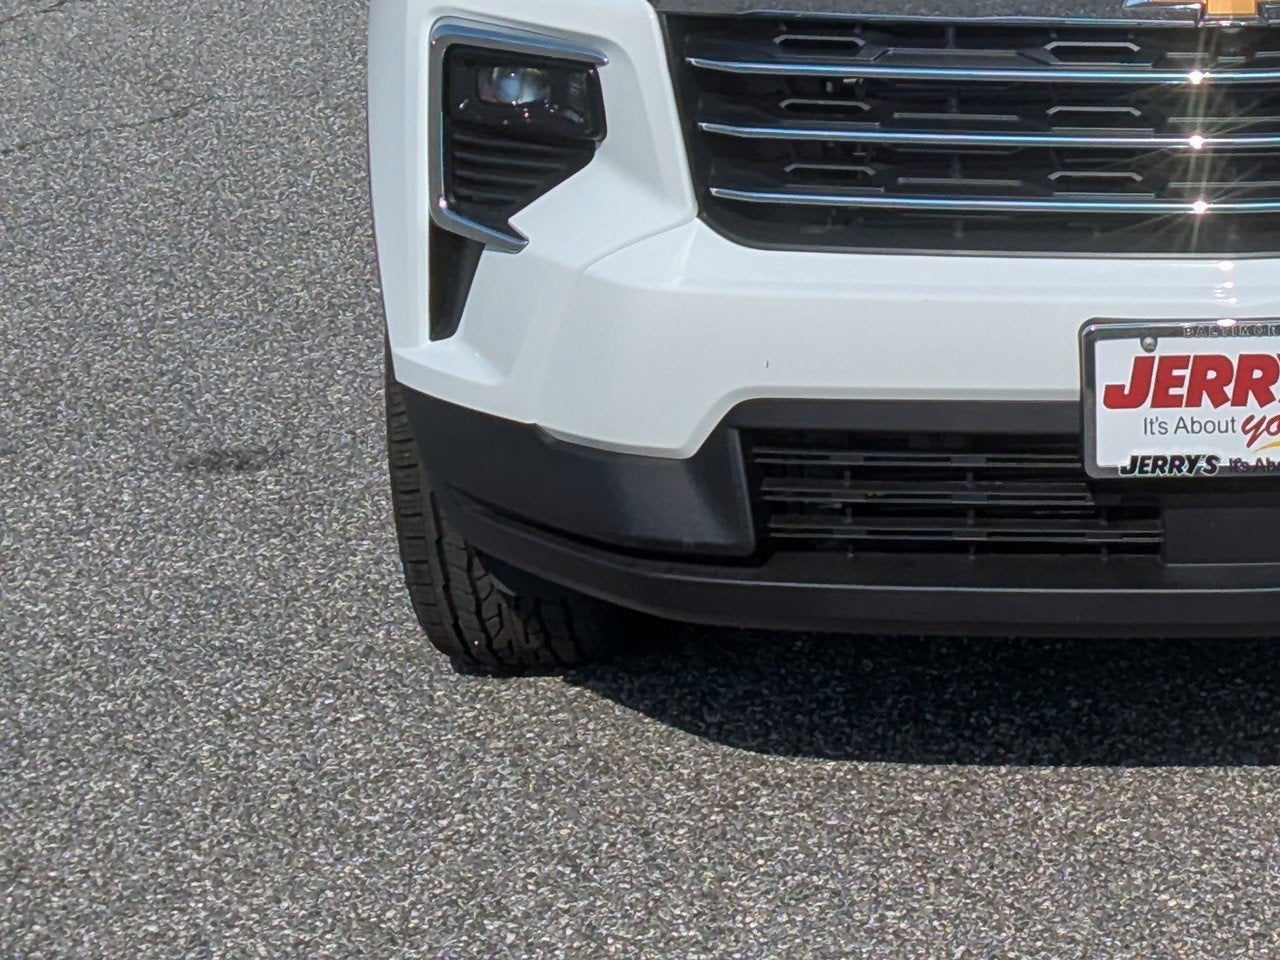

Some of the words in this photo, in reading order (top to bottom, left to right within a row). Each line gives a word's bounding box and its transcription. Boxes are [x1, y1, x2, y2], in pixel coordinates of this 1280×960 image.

[1143, 416, 1169, 436] It's
[1173, 414, 1236, 436] About
[1119, 454, 1221, 477] JERRY'S
